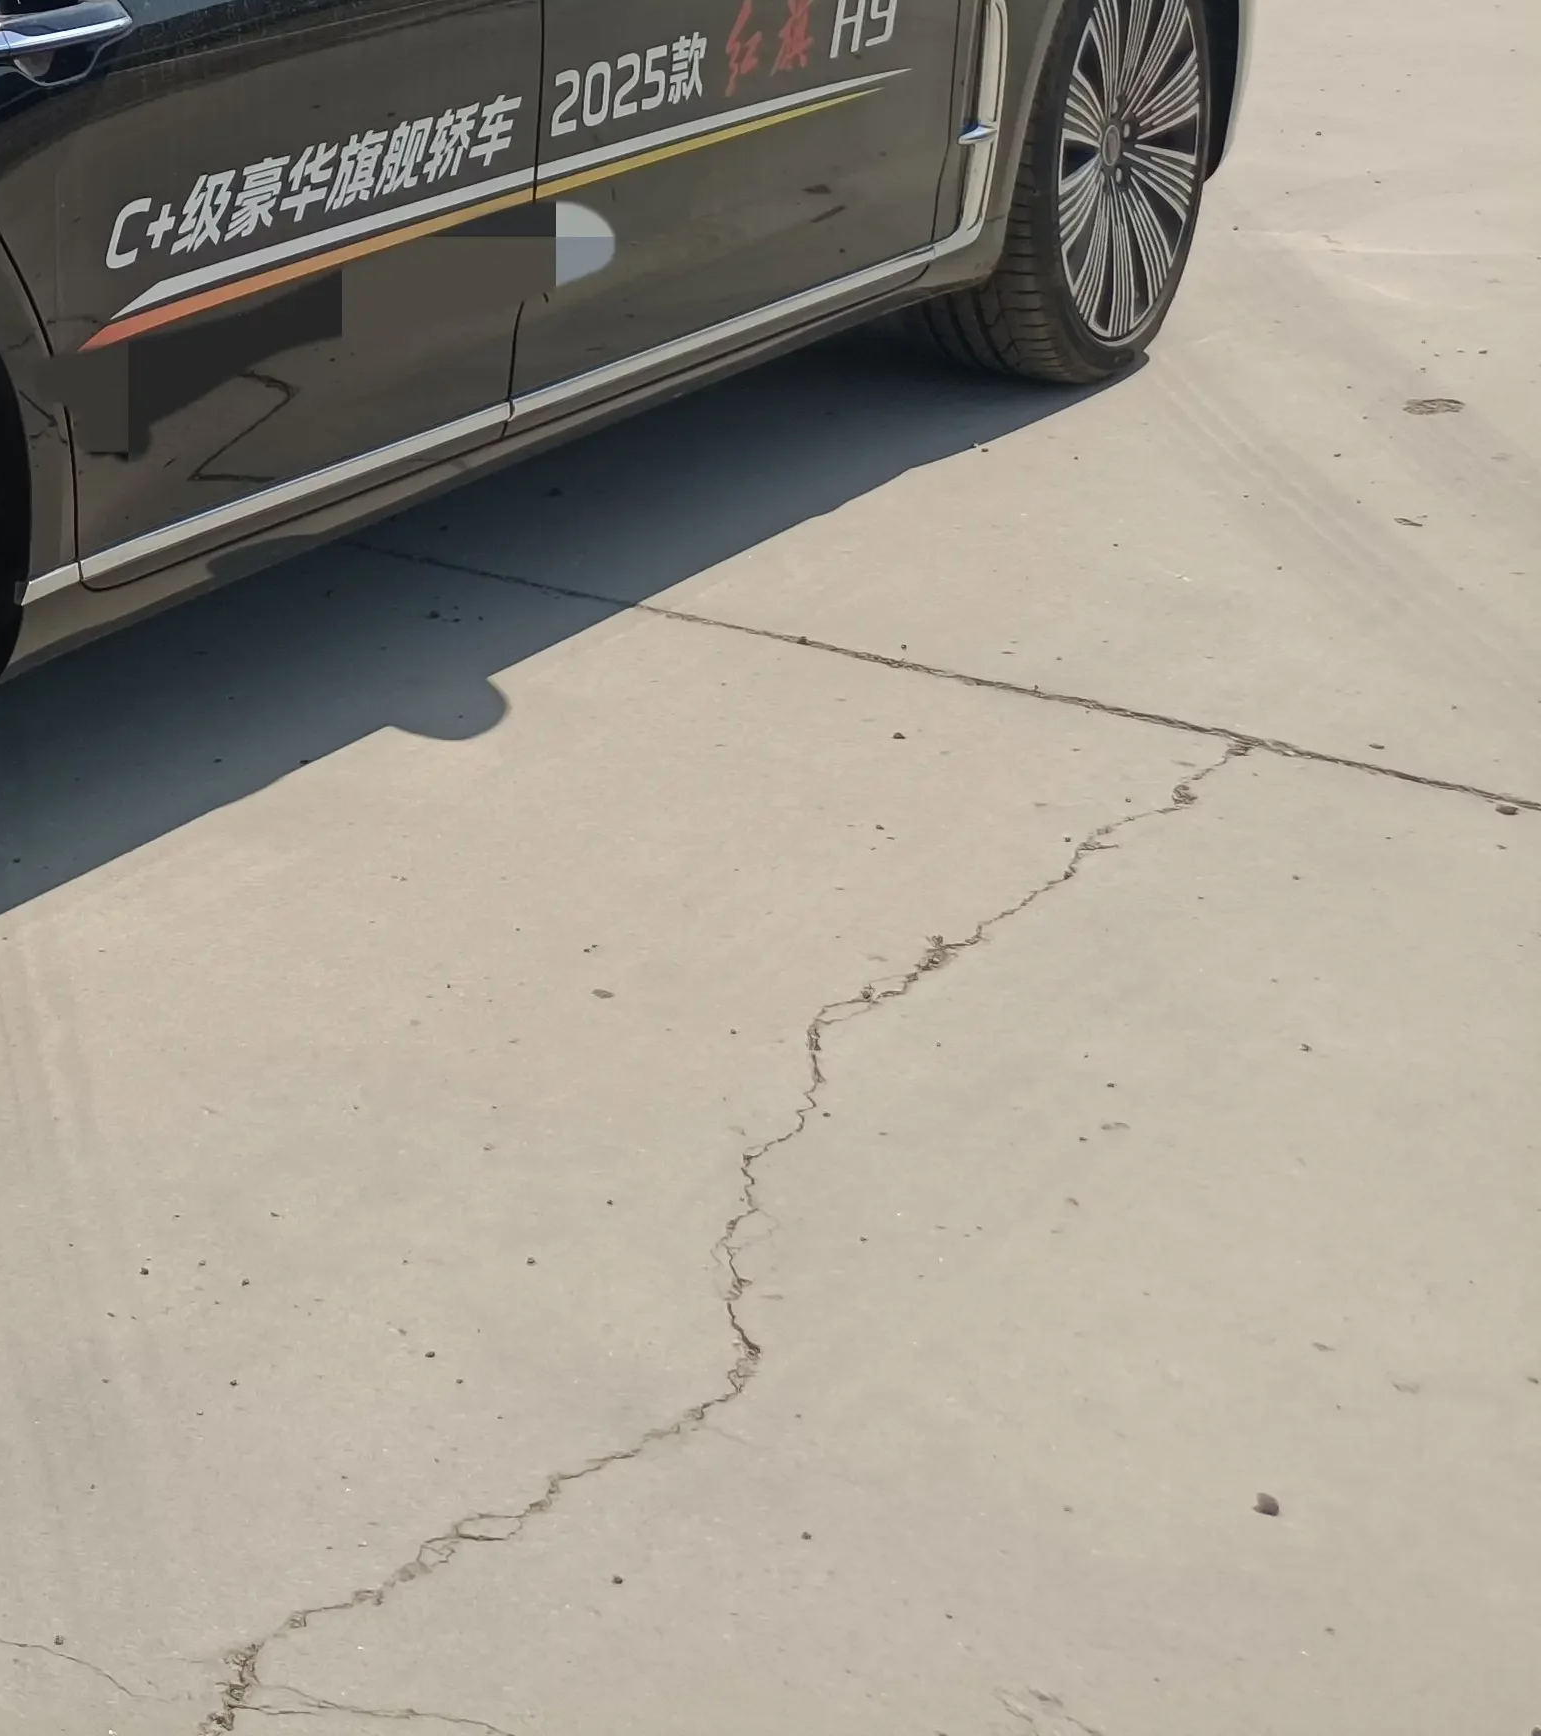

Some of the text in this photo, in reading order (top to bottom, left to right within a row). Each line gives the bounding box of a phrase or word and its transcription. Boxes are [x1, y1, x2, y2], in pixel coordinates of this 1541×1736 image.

[105, 94, 522, 269] C+级豪华旗舰轿车
[550, 31, 708, 137] 2025款
